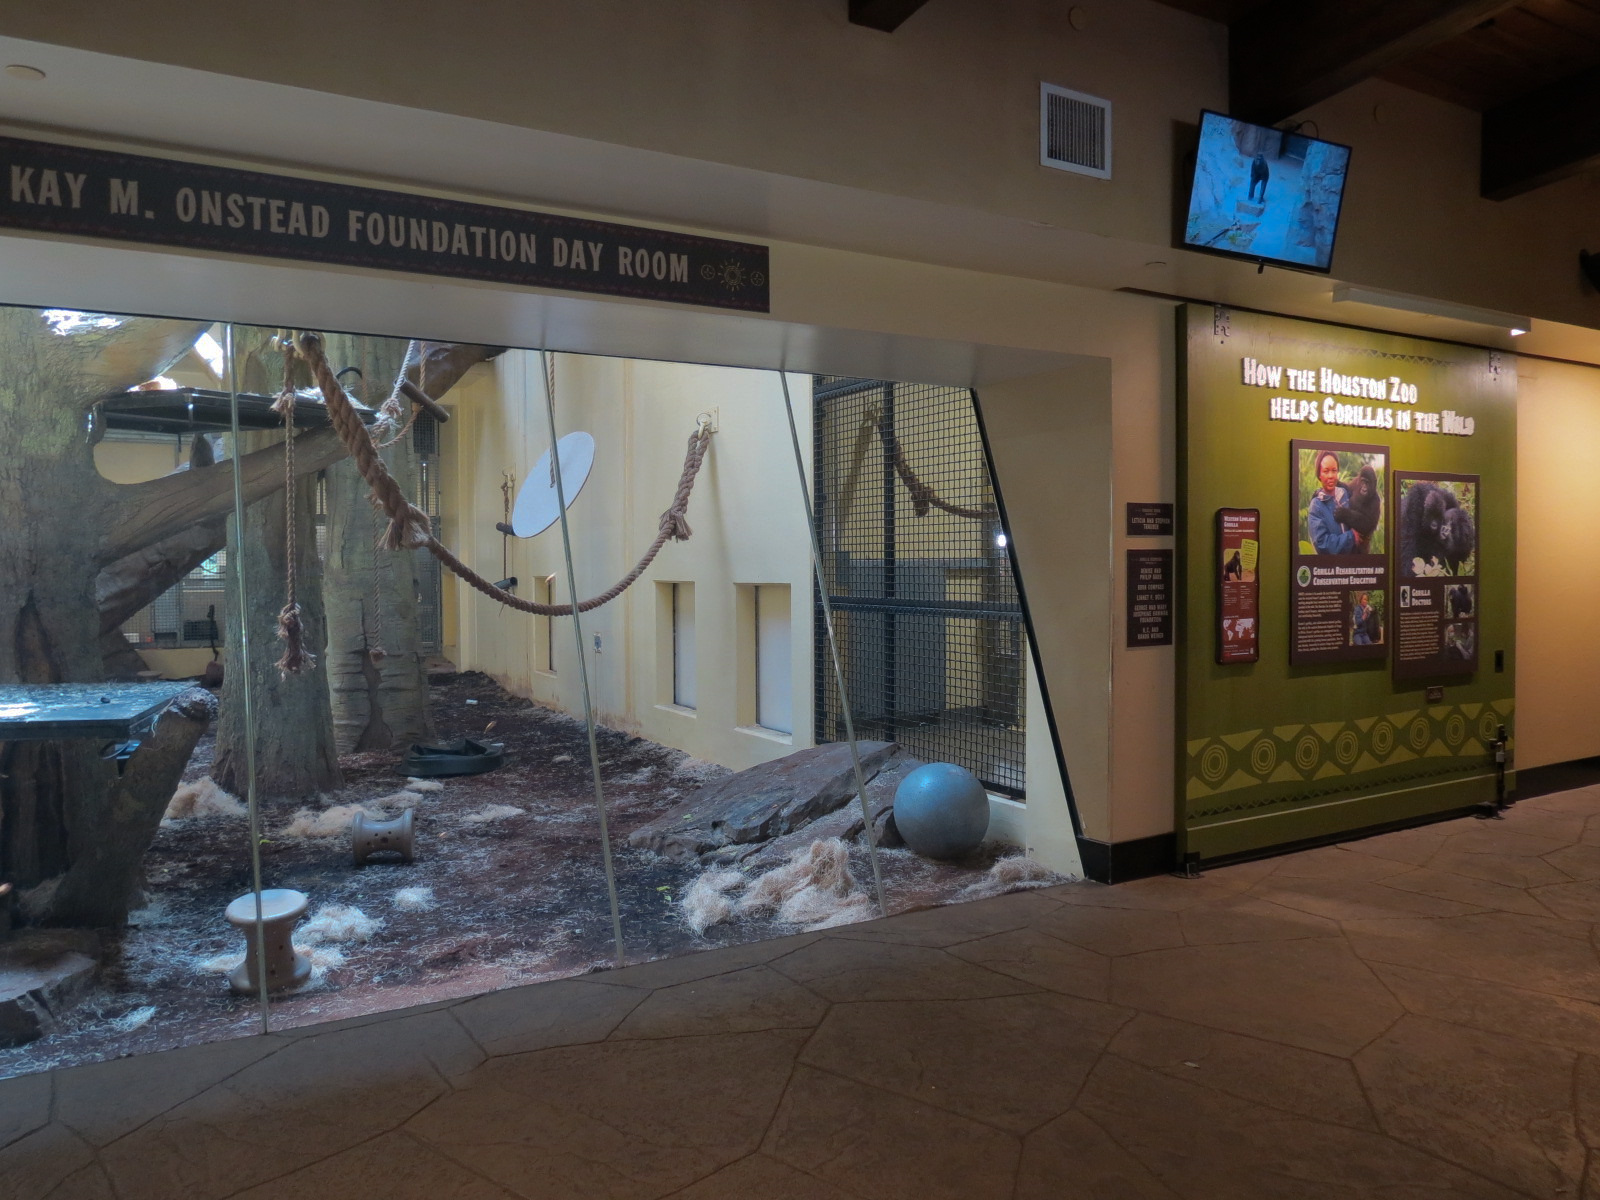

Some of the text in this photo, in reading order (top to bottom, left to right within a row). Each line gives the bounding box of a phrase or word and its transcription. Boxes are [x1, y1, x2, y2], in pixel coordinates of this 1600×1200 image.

[10, 165, 689, 283] KAY M. ONSTEAD FOUNDATION DAY ROOM
[1241, 357, 1418, 404] HOW THE HOUSTON ZOO
[1270, 397, 1475, 436] HELPS GORILLAS IN THE WILD
[1313, 567, 1334, 576] GORILLA
[1335, 566, 1374, 575] REHABILITATION
[1313, 576, 1377, 586] CONSERVATION EDUCATION
[1411, 588, 1431, 597] GORILLA
[1411, 597, 1432, 606] DOCTORS
